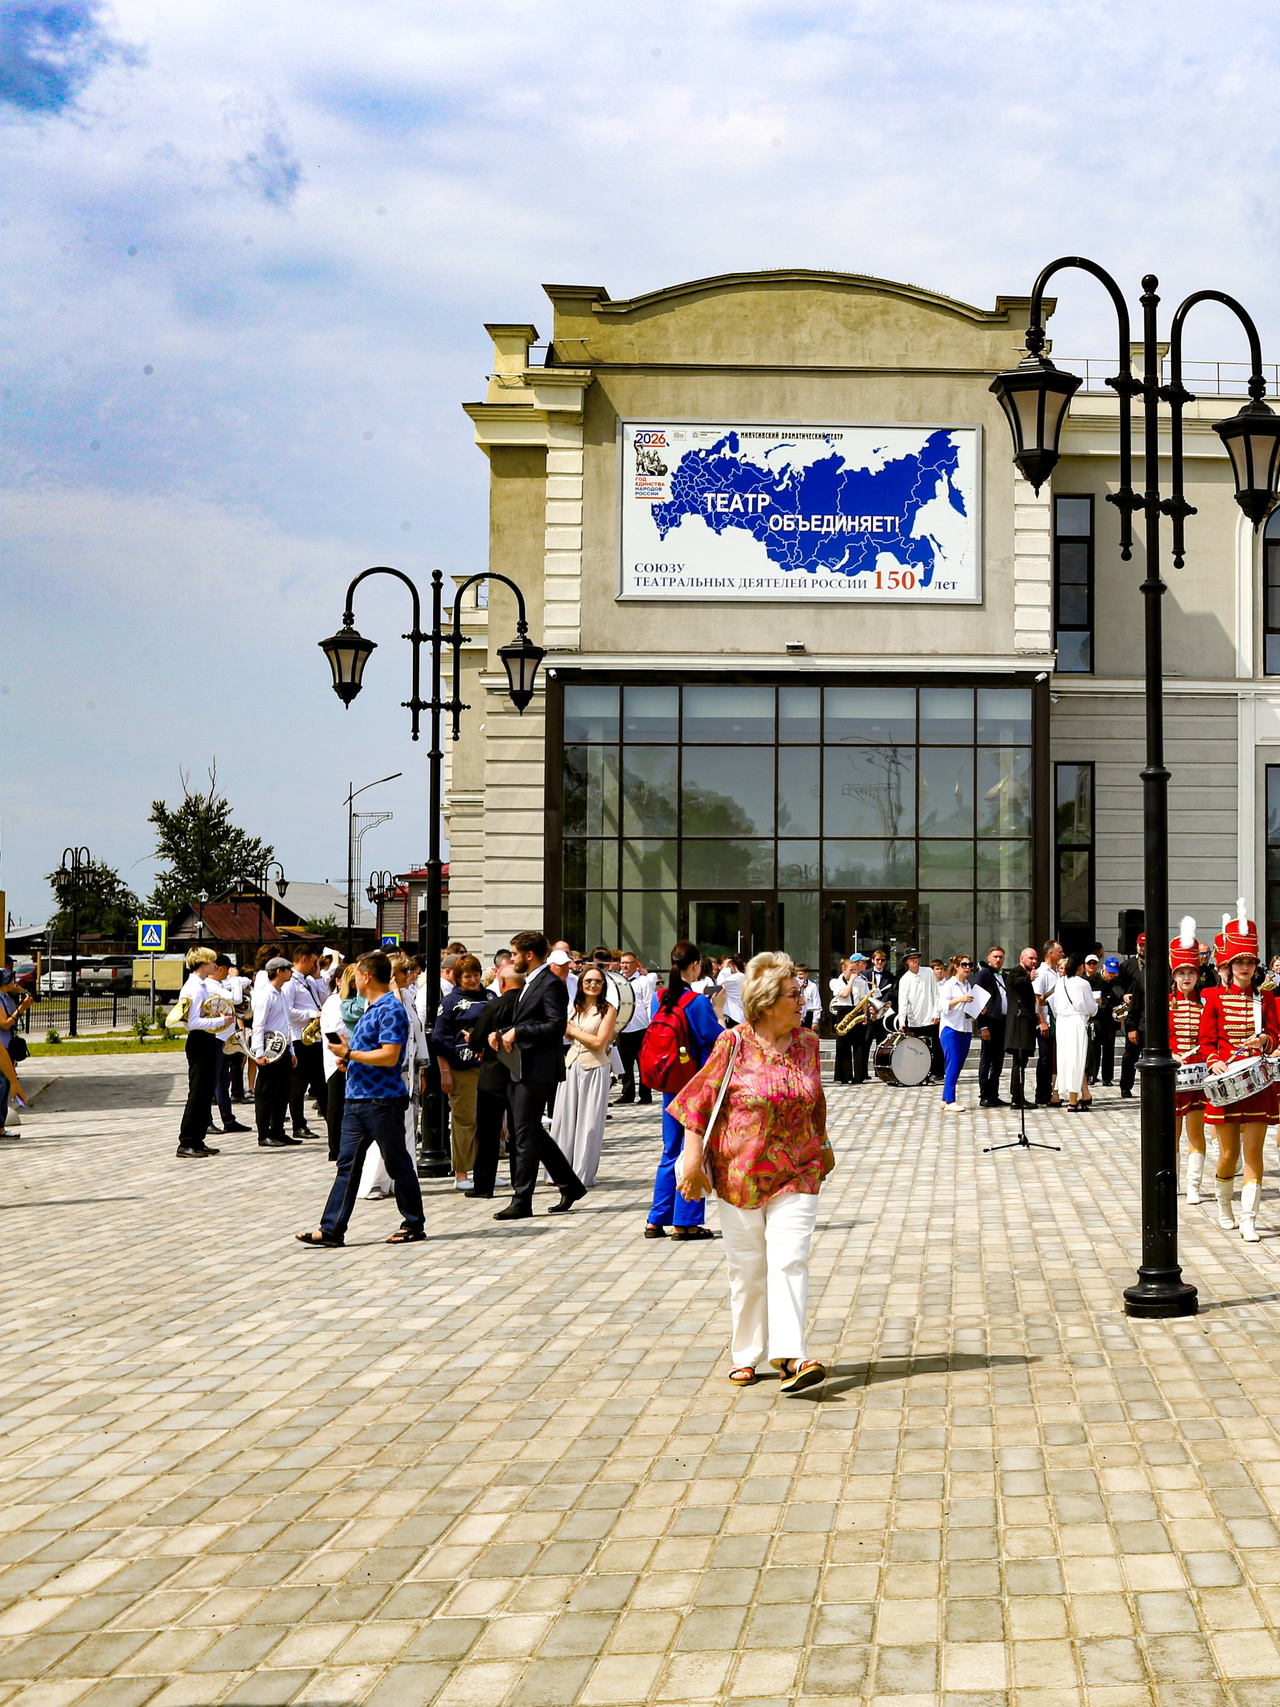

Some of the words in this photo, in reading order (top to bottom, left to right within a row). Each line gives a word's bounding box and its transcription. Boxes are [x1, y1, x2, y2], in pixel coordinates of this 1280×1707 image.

[635, 433, 666, 444] 2026
[826, 433, 844, 441] ТЕАТР
[703, 492, 771, 513] ТЕАТР
[769, 514, 900, 535] ОБЪЕДИНЯЕТ!
[634, 562, 685, 574] СОЮЗУ
[634, 576, 735, 589] ТЕАТРАЛЬНЫХ
[738, 576, 807, 590] ДЕЯТЕЛЕЙ
[811, 578, 868, 590] РОССИИ
[874, 570, 915, 590] 150
[934, 580, 958, 592] лет
